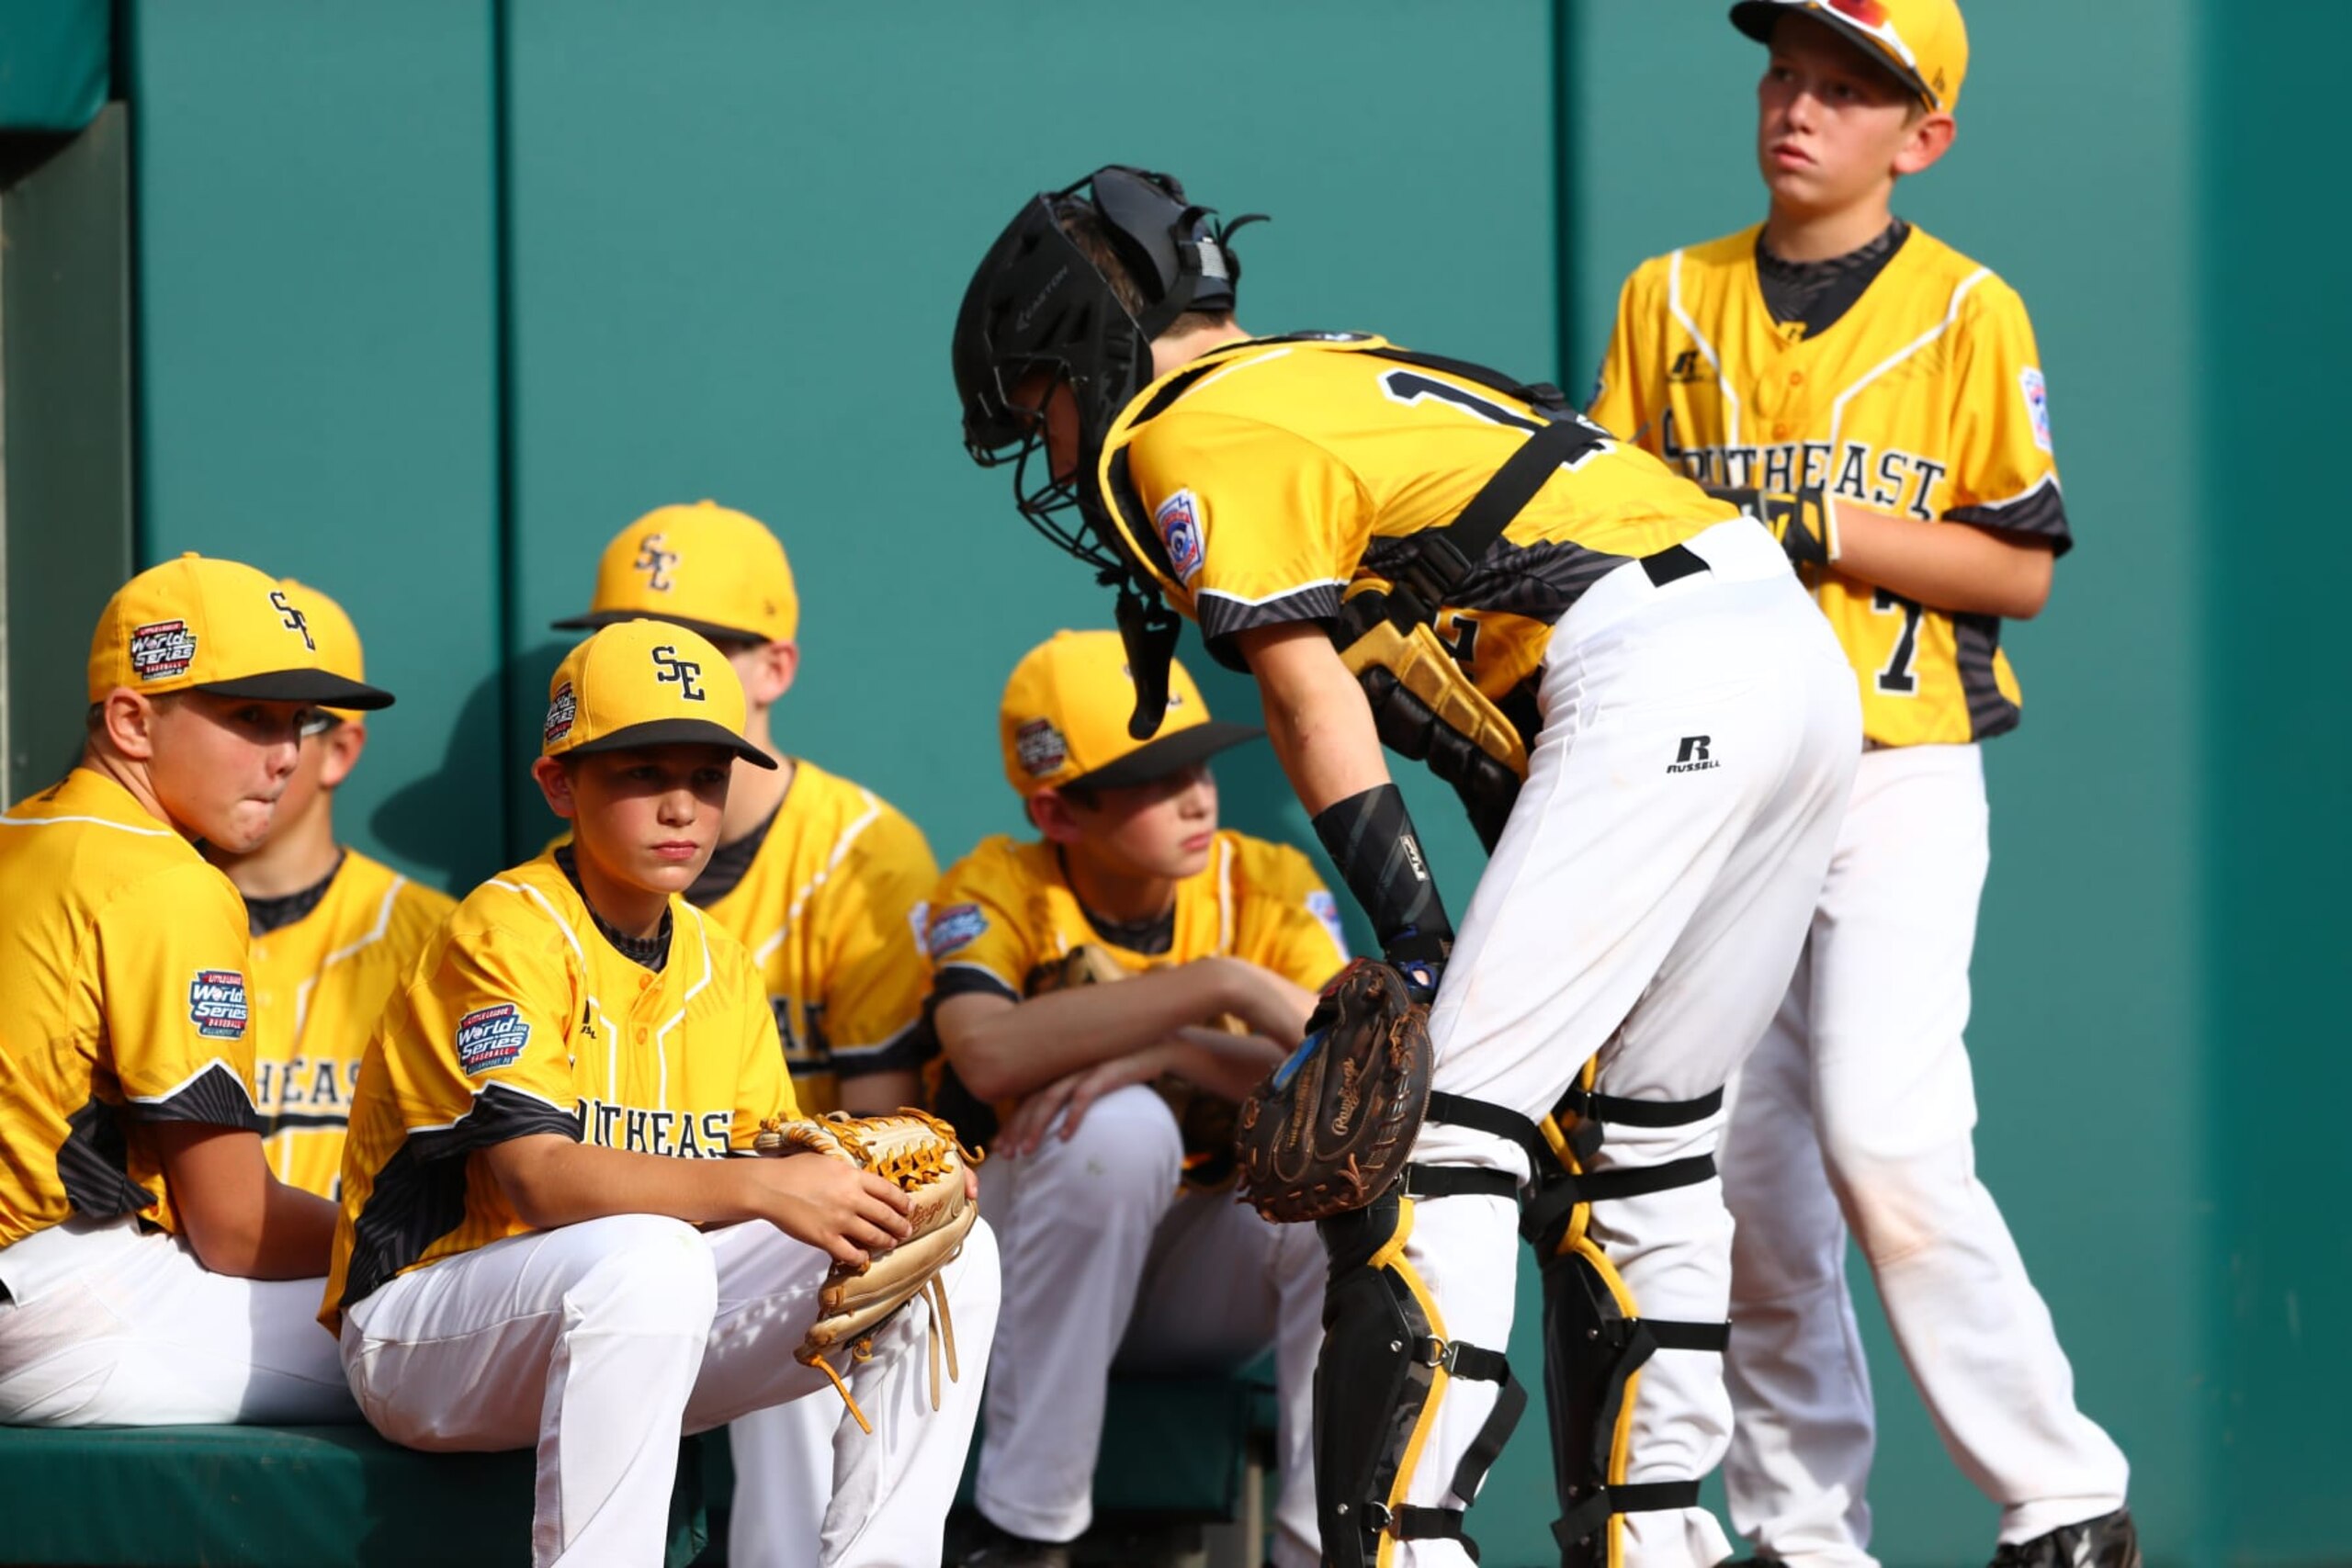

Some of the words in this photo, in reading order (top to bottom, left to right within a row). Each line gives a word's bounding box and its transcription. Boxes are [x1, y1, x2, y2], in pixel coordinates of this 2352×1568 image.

[634, 533, 677, 592] SE
[270, 592, 316, 651] SE
[131, 630, 187, 653] World
[1871, 586, 1924, 693] 7
[134, 644, 194, 667] Series
[651, 646, 706, 702] SE
[1676, 735, 1712, 763] R
[1666, 759, 1721, 773] RUSSELL
[193, 984, 243, 1002] World
[194, 1000, 247, 1021] Series
[459, 1017, 515, 1046] World
[461, 1032, 526, 1060] Series
[1332, 1057, 1359, 1136] Rawlings
